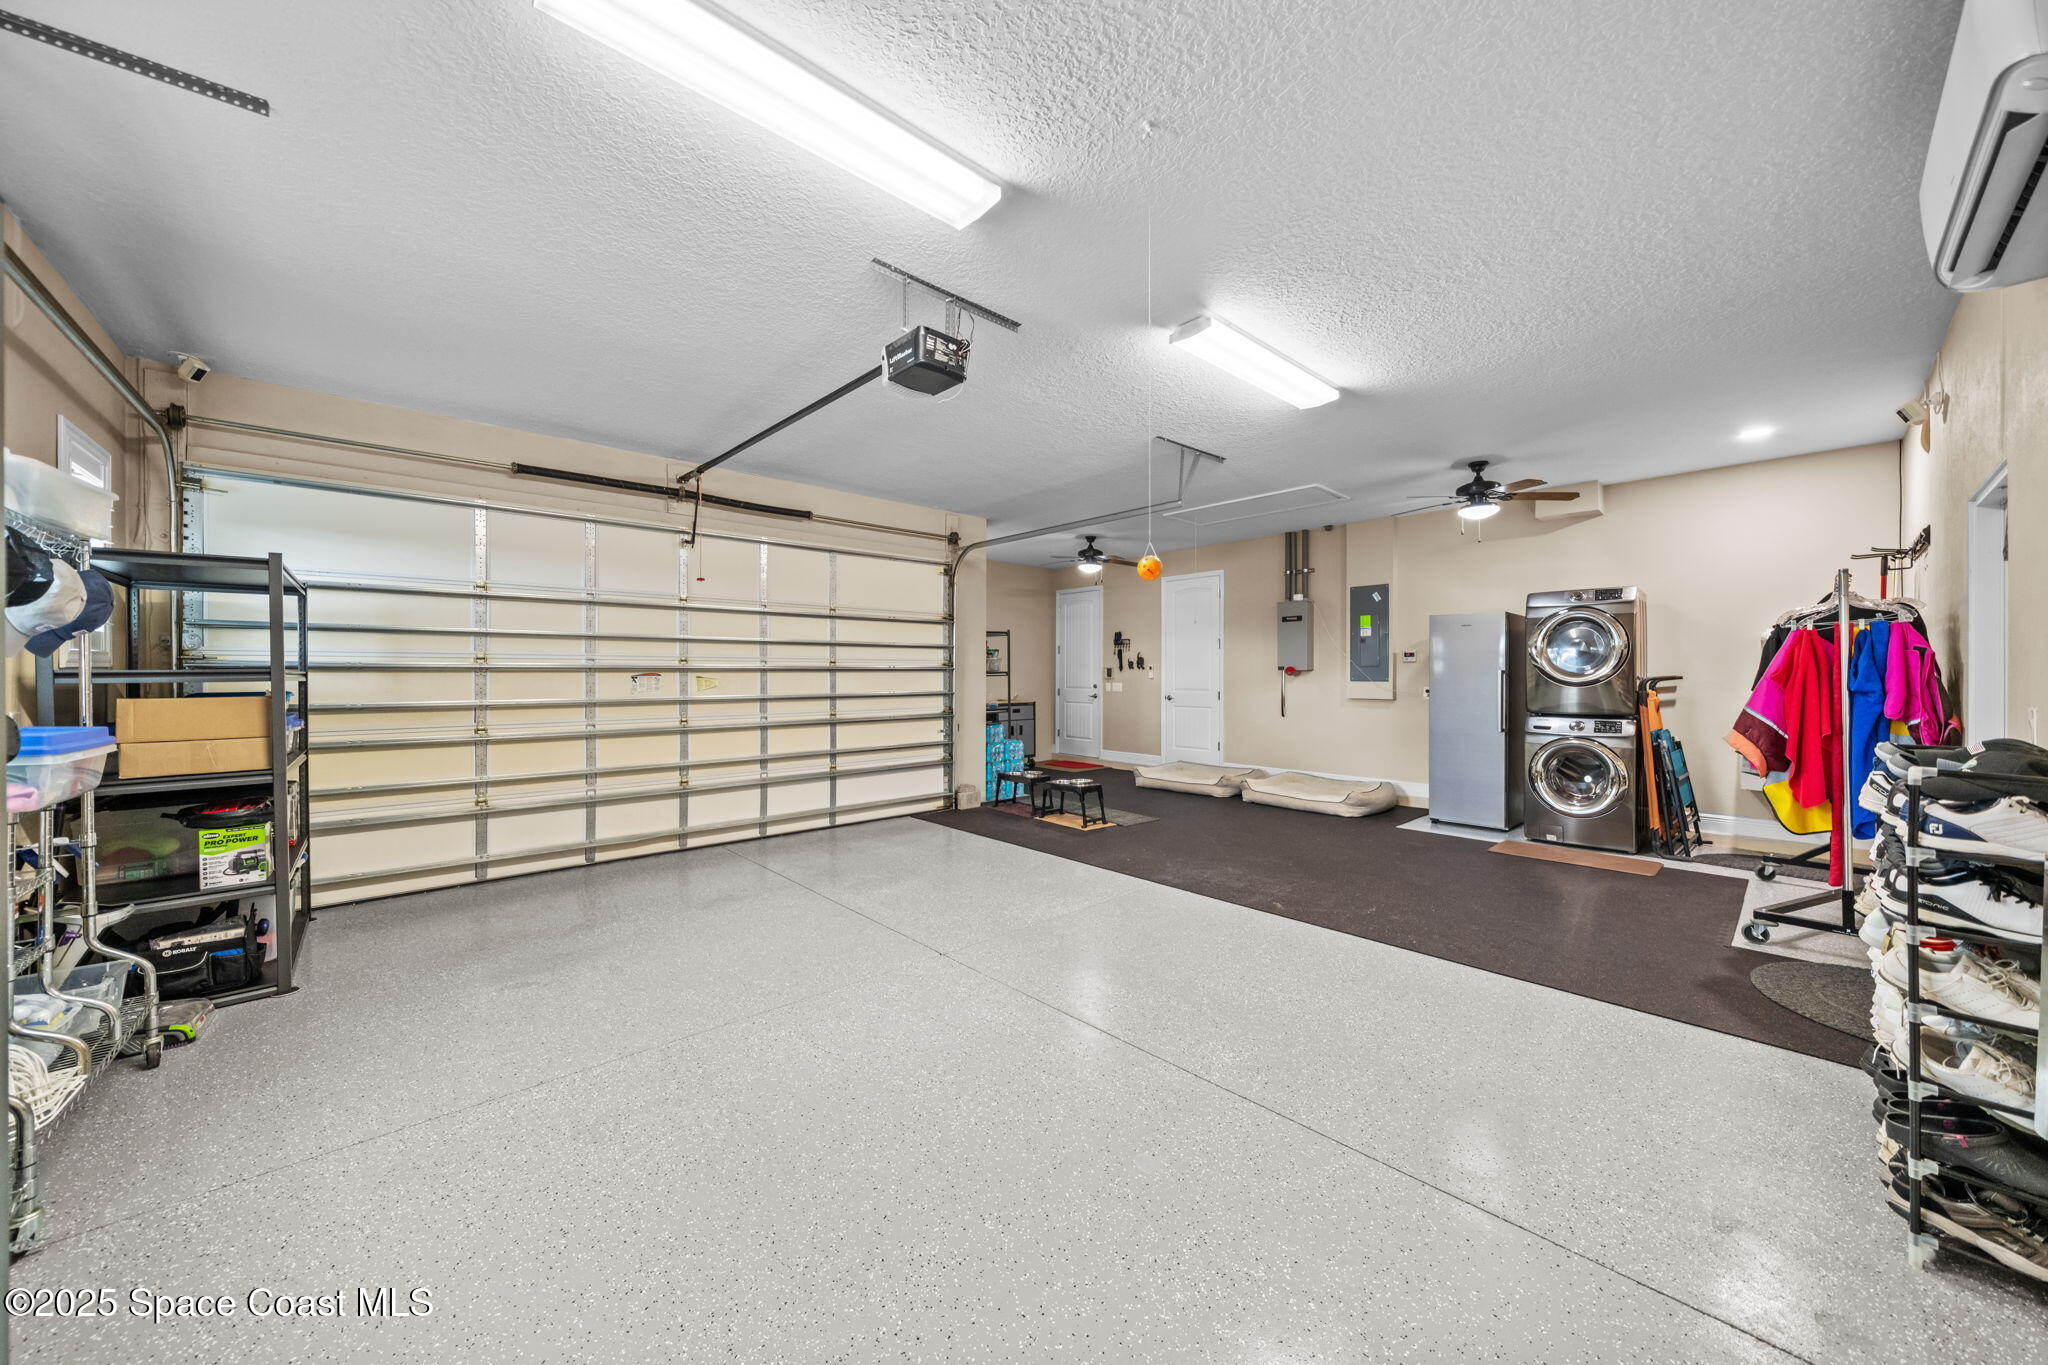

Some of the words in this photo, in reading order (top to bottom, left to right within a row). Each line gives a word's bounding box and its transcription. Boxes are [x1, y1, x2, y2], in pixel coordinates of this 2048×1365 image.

[1929, 823, 1943, 835] FJ
[204, 839, 224, 847] PRO
[226, 835, 258, 844] POWER
[172, 946, 197, 955] KOBALT
